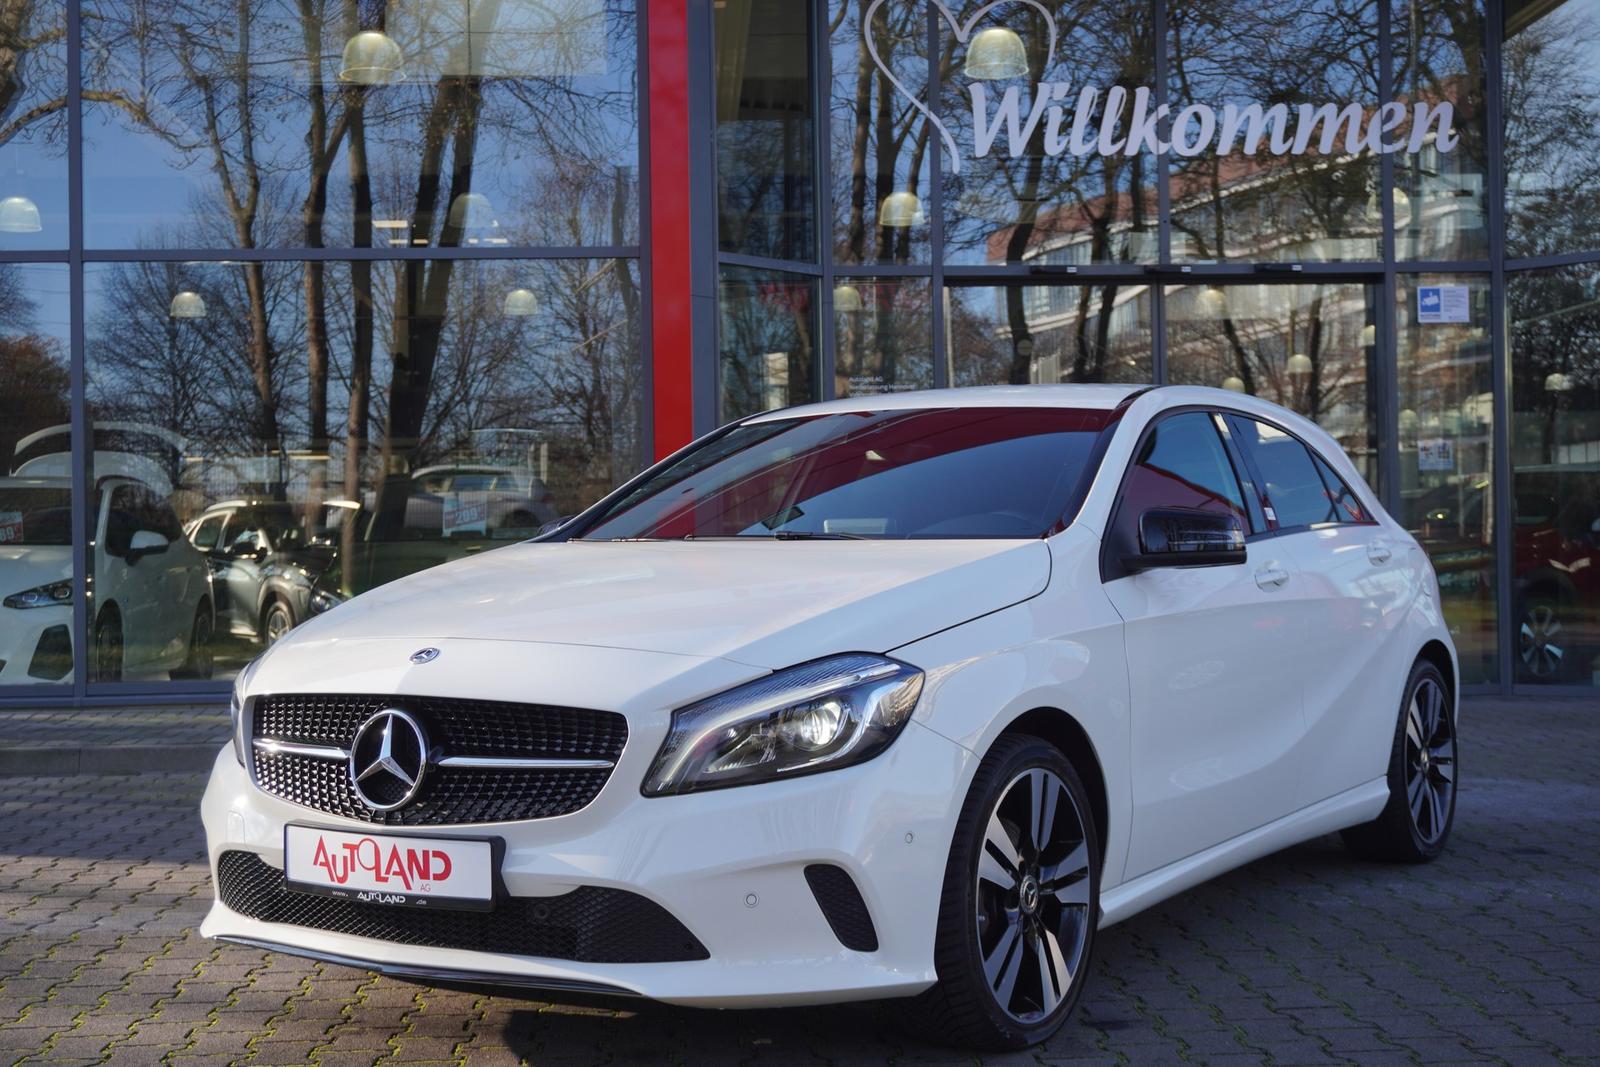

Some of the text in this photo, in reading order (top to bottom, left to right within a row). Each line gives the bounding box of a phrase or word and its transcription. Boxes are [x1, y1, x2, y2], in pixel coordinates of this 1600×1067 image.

[967, 82, 1460, 158] Willkommen
[313, 835, 452, 891] AUTOLAND
[420, 883, 431, 893] AG
